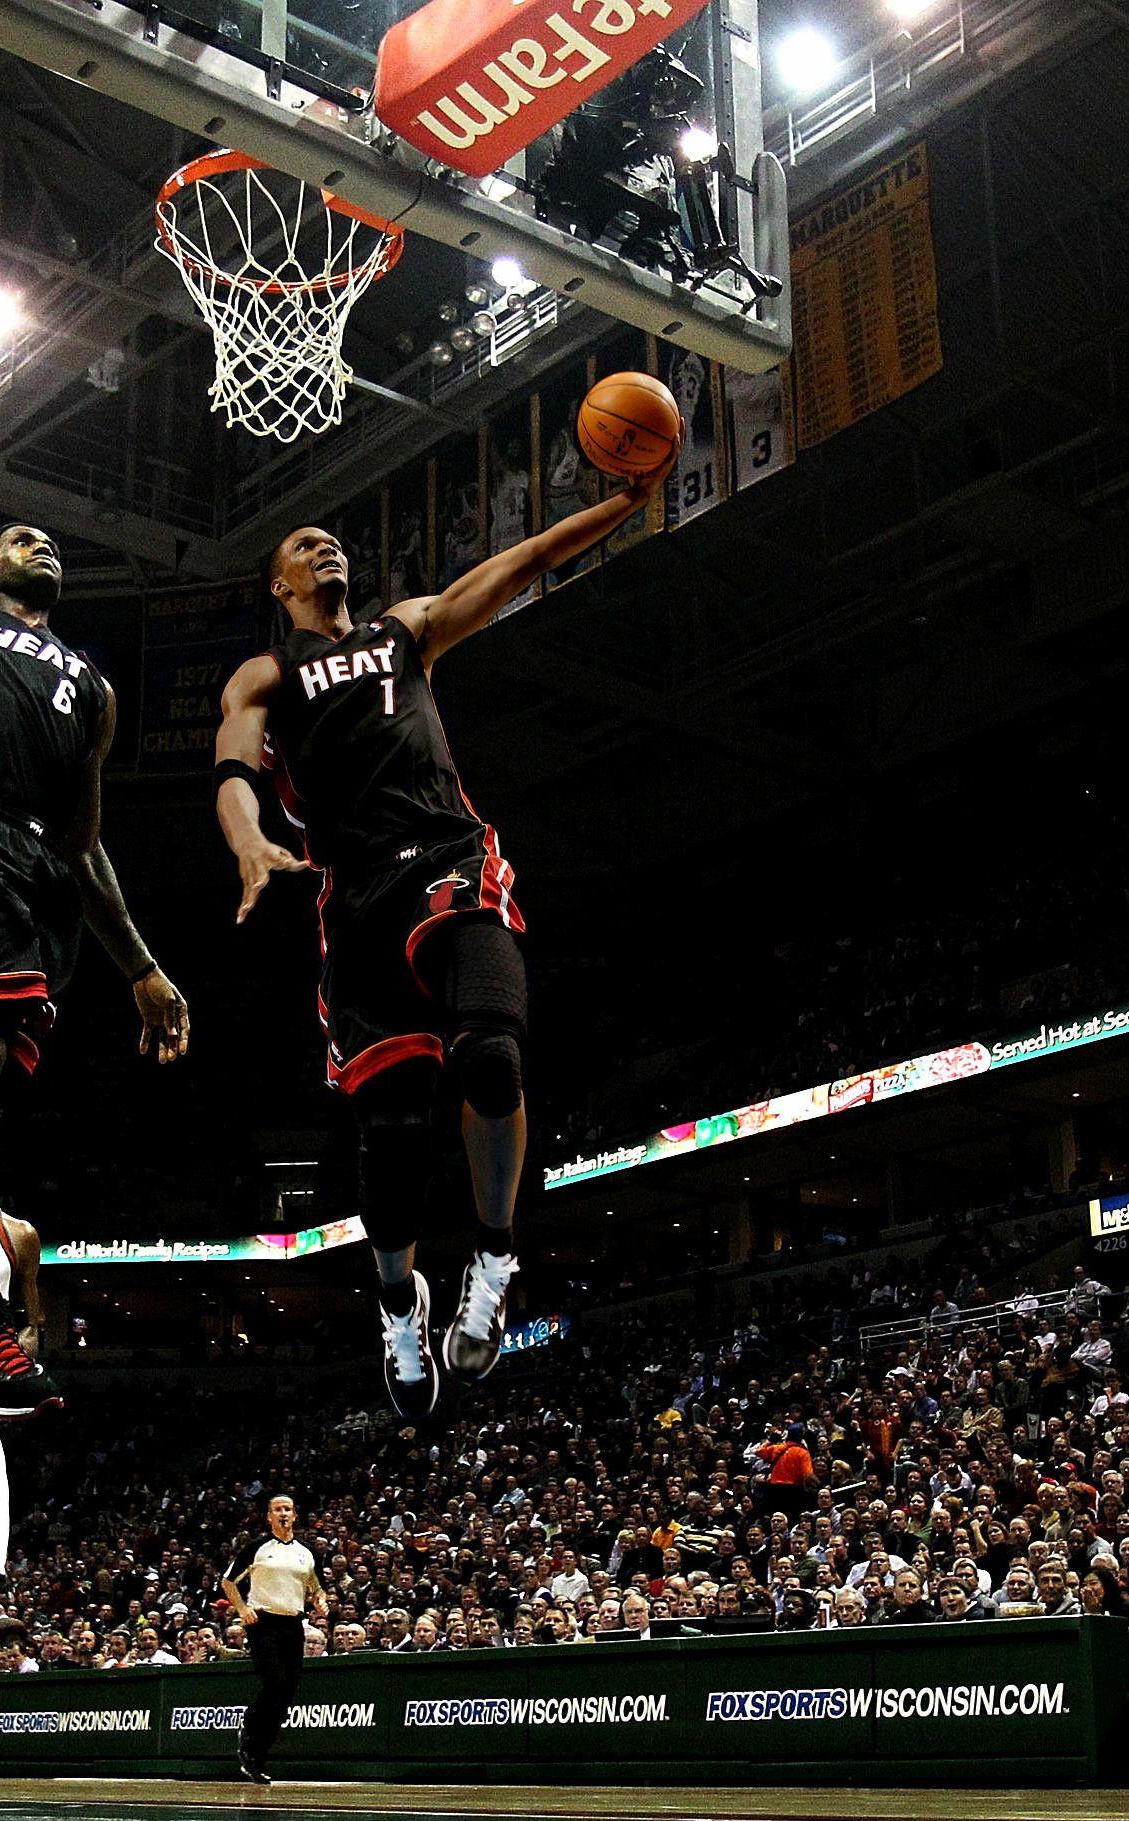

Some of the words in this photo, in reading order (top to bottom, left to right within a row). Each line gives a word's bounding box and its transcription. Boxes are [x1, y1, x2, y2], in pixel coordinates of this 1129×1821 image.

[751, 430, 773, 468] 3
[683, 463, 715, 508] 31
[299, 637, 396, 700] HEAT
[51, 679, 76, 715] 6
[168, 698, 218, 719] NCA
[380, 678, 395, 715] 1
[143, 728, 216, 752] CHAMP
[991, 1024, 1047, 1062] Served
[1048, 1022, 1082, 1047] Hot
[1083, 1017, 1102, 1037] at
[564, 1154, 597, 1178] Italian
[597, 1144, 647, 1168] Heritage
[1102, 1203, 1129, 1228] M&
[57, 1240, 86, 1258] Old
[86, 1240, 128, 1258] World
[173, 1241, 230, 1261] Recipes
[1094, 1235, 1127, 1253] 4226
[404, 1694, 669, 1726] FOXSPORTSWISCONSIN.COM
[706, 1682, 1069, 1722] FOXSPORTSWISCONSIN.COM
